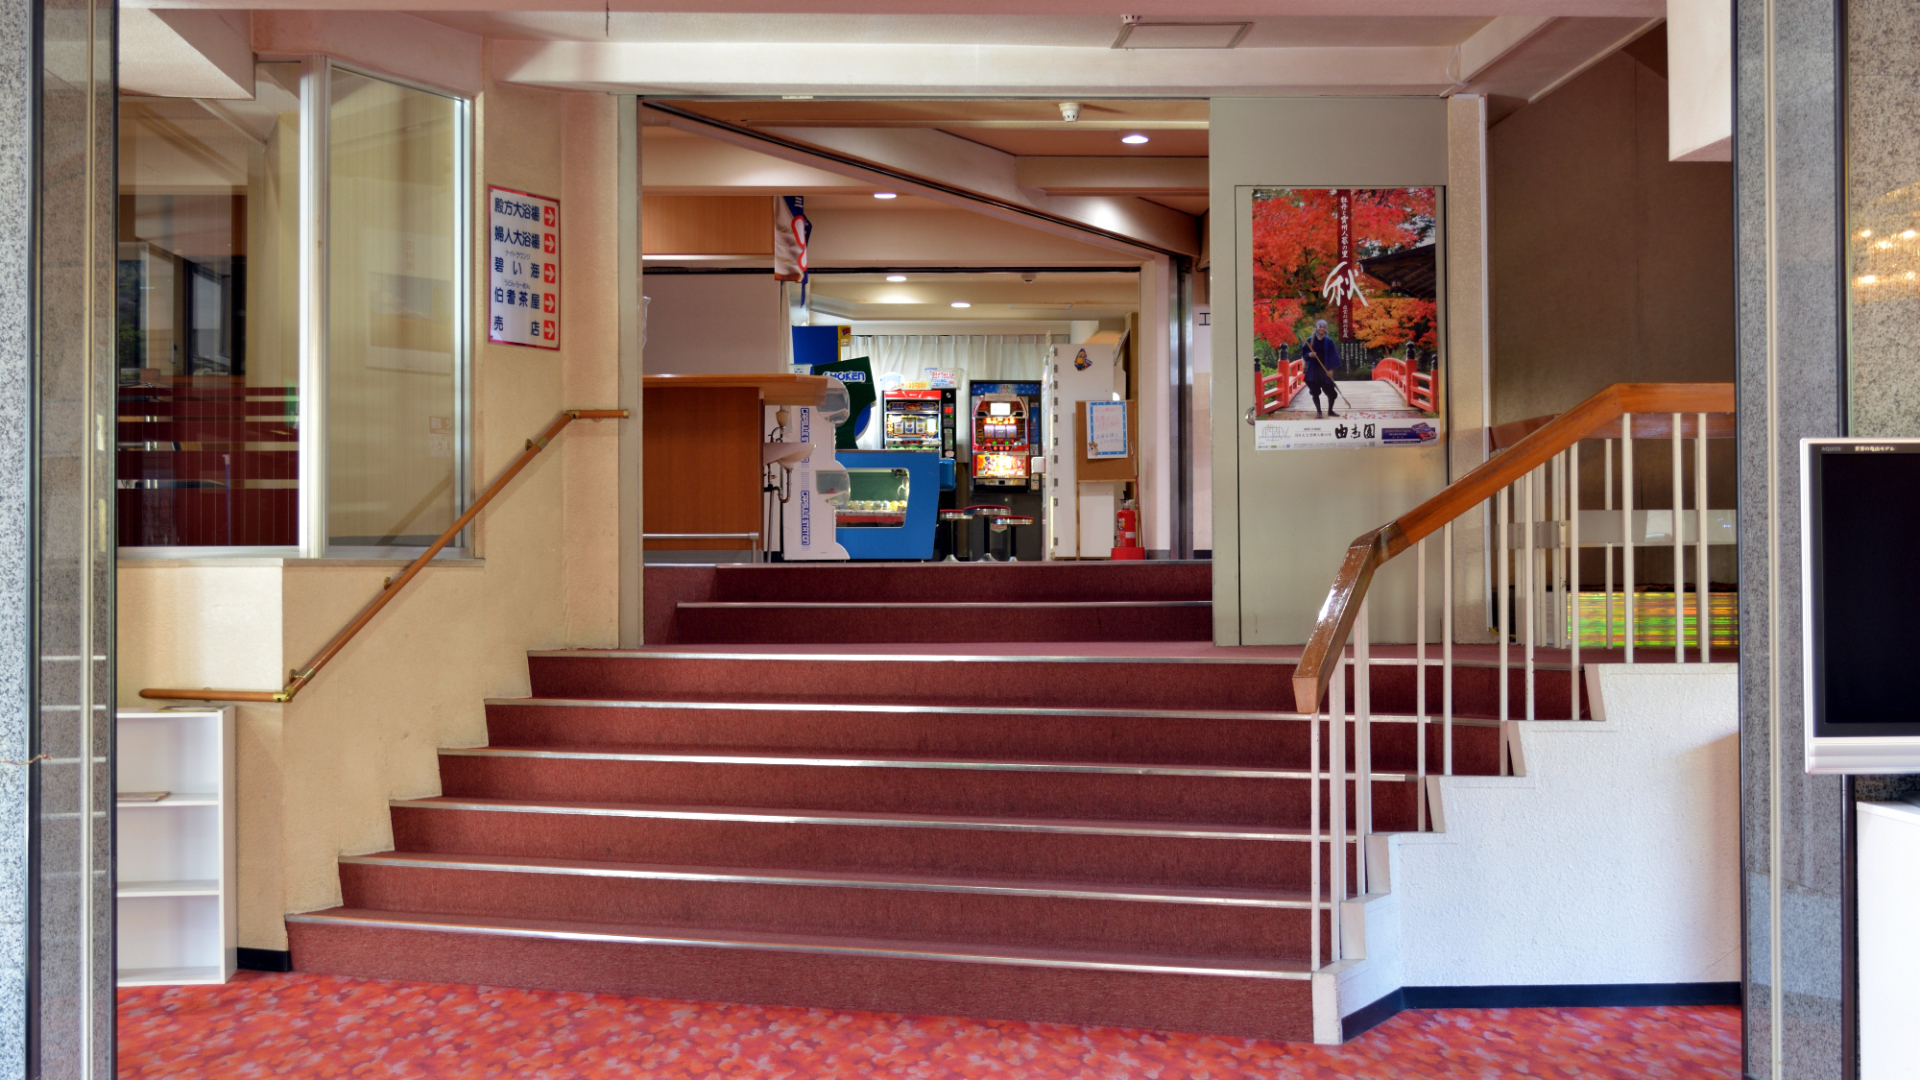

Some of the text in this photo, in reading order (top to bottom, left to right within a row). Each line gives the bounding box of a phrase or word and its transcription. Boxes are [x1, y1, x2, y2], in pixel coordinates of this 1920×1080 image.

[494, 197, 540, 222] 殿方大浴場
[494, 225, 540, 249] 婦人大浴場
[1323, 261, 1369, 307] 秋
